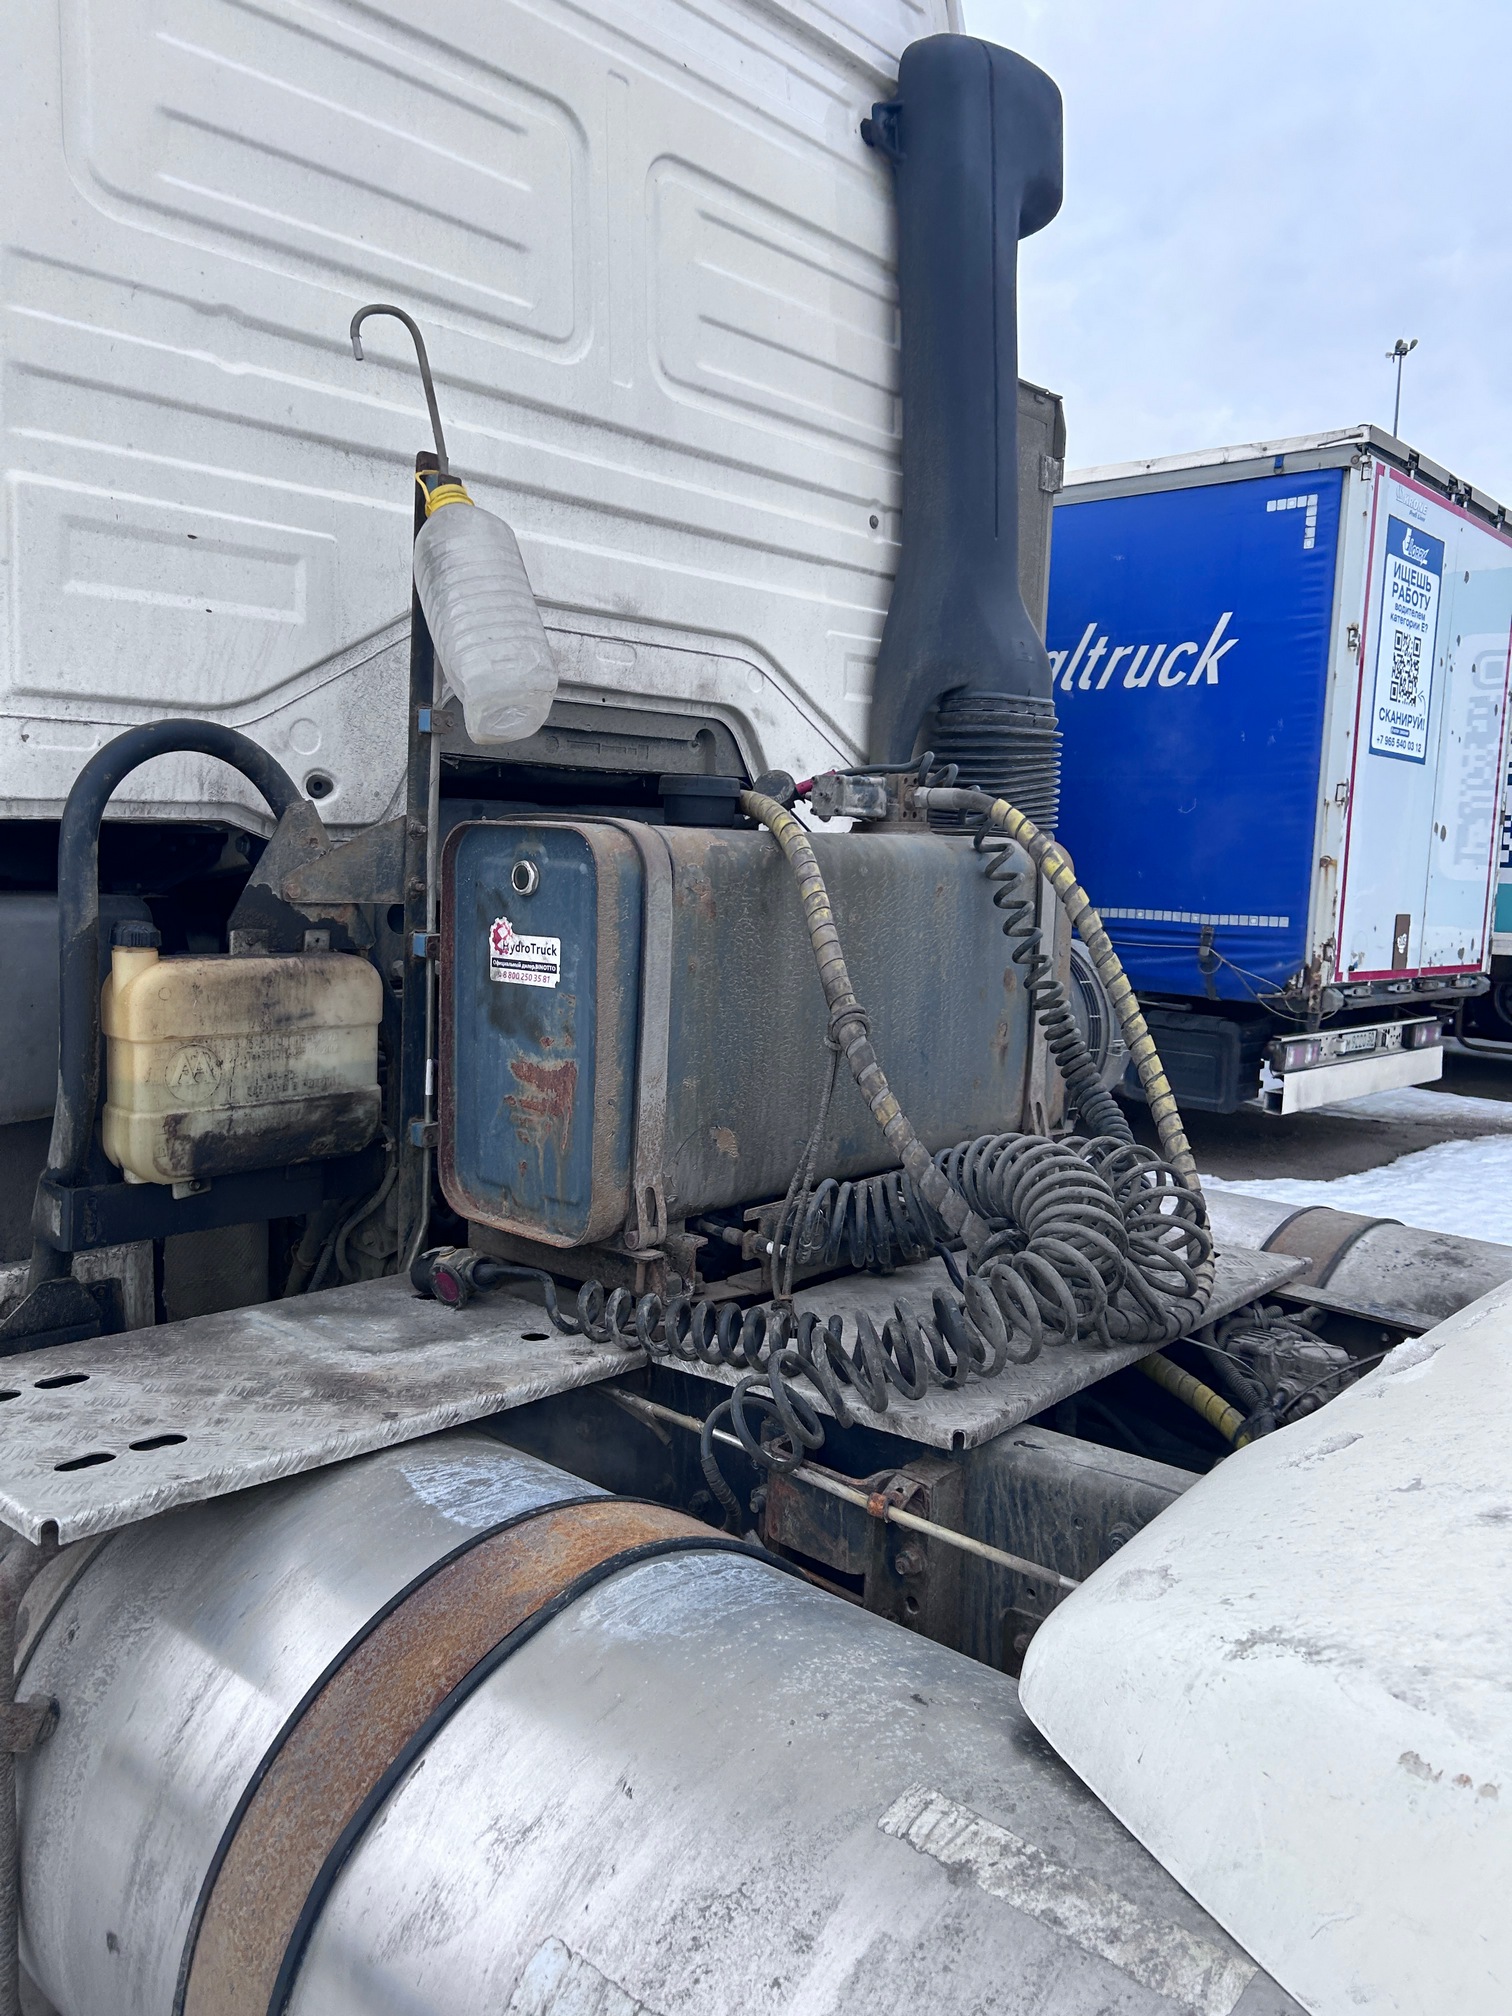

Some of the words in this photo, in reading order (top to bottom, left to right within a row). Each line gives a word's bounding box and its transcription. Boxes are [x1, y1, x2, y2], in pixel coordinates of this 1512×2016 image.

[1393, 561, 1432, 592] ИЩЕШЬ
[1391, 581, 1431, 611] РАБОТУ
[1394, 602, 1426, 621] водителем
[1390, 612, 1420, 631] категории
[1379, 707, 1426, 731] СКАНИРУЙ!
[1376, 734, 1384, 744] +7
[1407, 740, 1415, 751] 03
[1415, 743, 1422, 753] 12
[502, 941, 558, 957] HydroTruck
[508, 971, 520, 980] 800
[520, 972, 533, 982] 250
[533, 974, 542, 983] 35
[542, 975, 551, 984] 81
